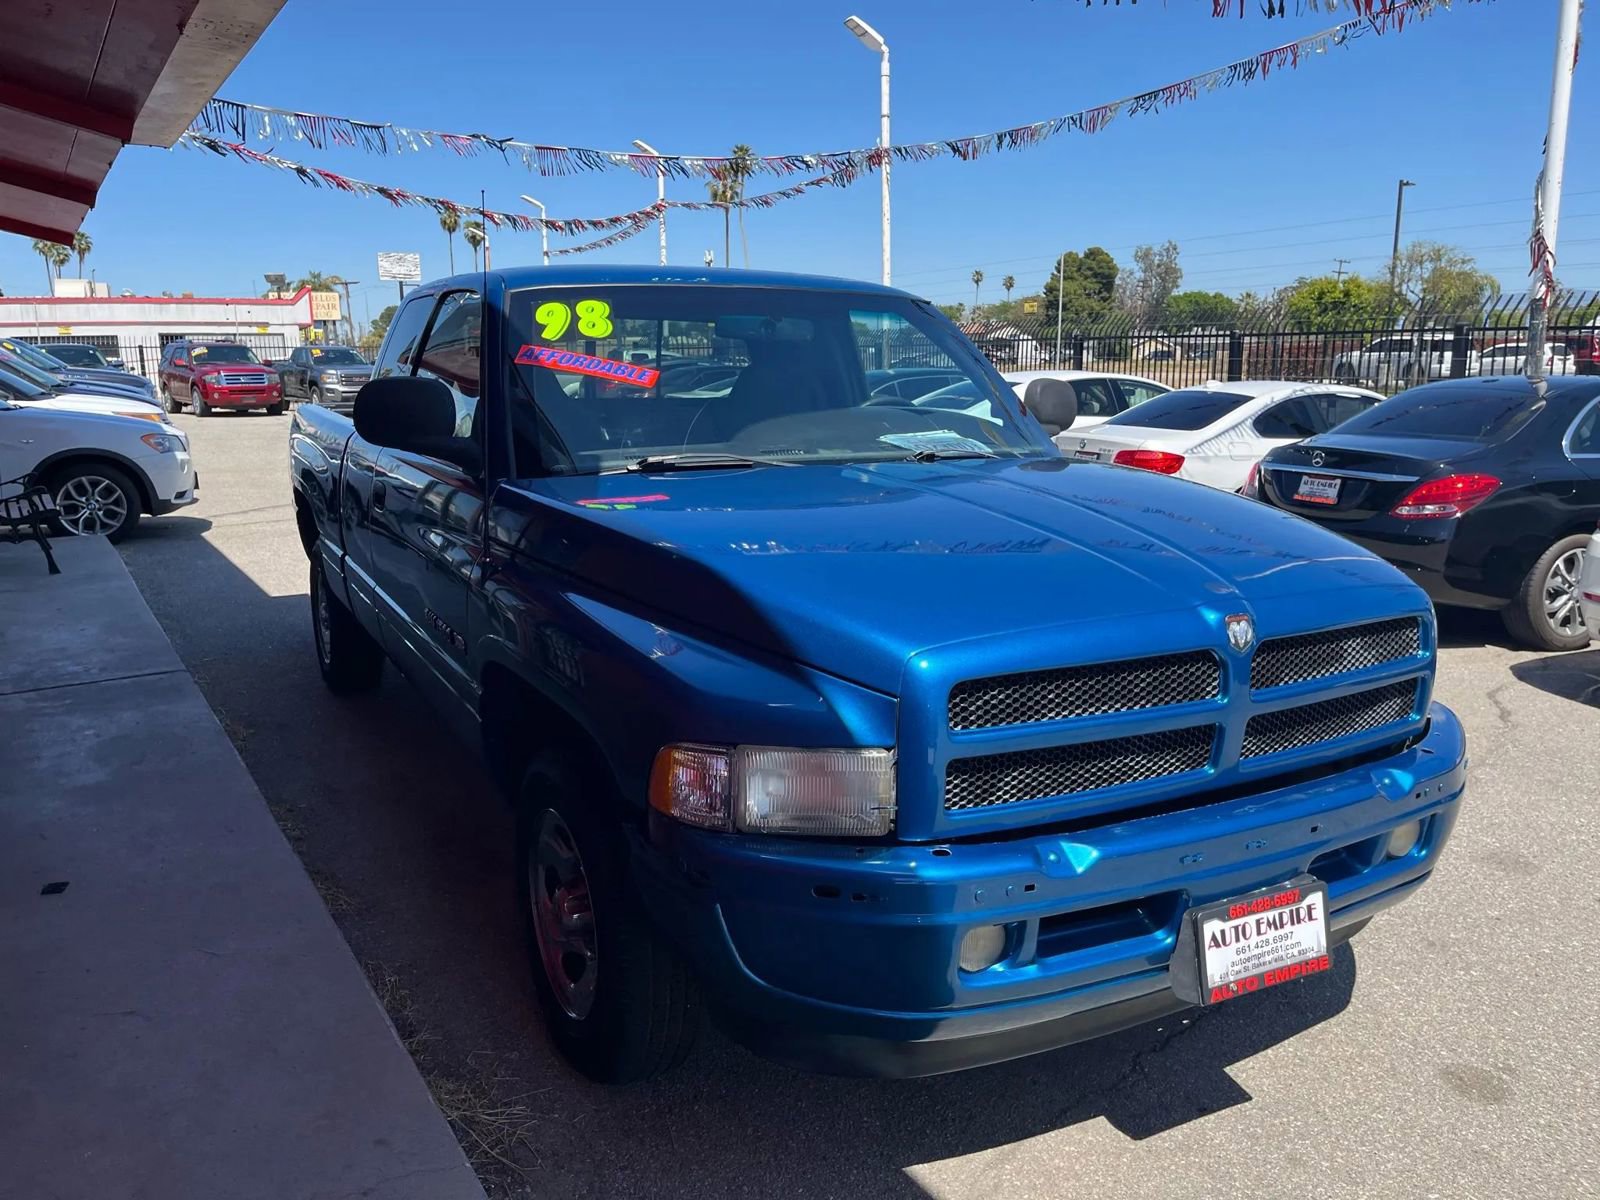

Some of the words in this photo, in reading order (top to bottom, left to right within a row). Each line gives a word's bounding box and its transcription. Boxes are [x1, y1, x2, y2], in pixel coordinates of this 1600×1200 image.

[311, 294, 337, 302] IELDS
[534, 300, 613, 341] 98
[517, 346, 653, 383] AFFORDABLE
[1207, 922, 1252, 951] AUTO
[1255, 902, 1318, 937] EMPIRE
[1235, 931, 1294, 956] 661.428.6997
[1230, 940, 1302, 969] autoempire661.com
[1210, 977, 1260, 1003] AUTO
[1263, 954, 1330, 987] EMPIRE
